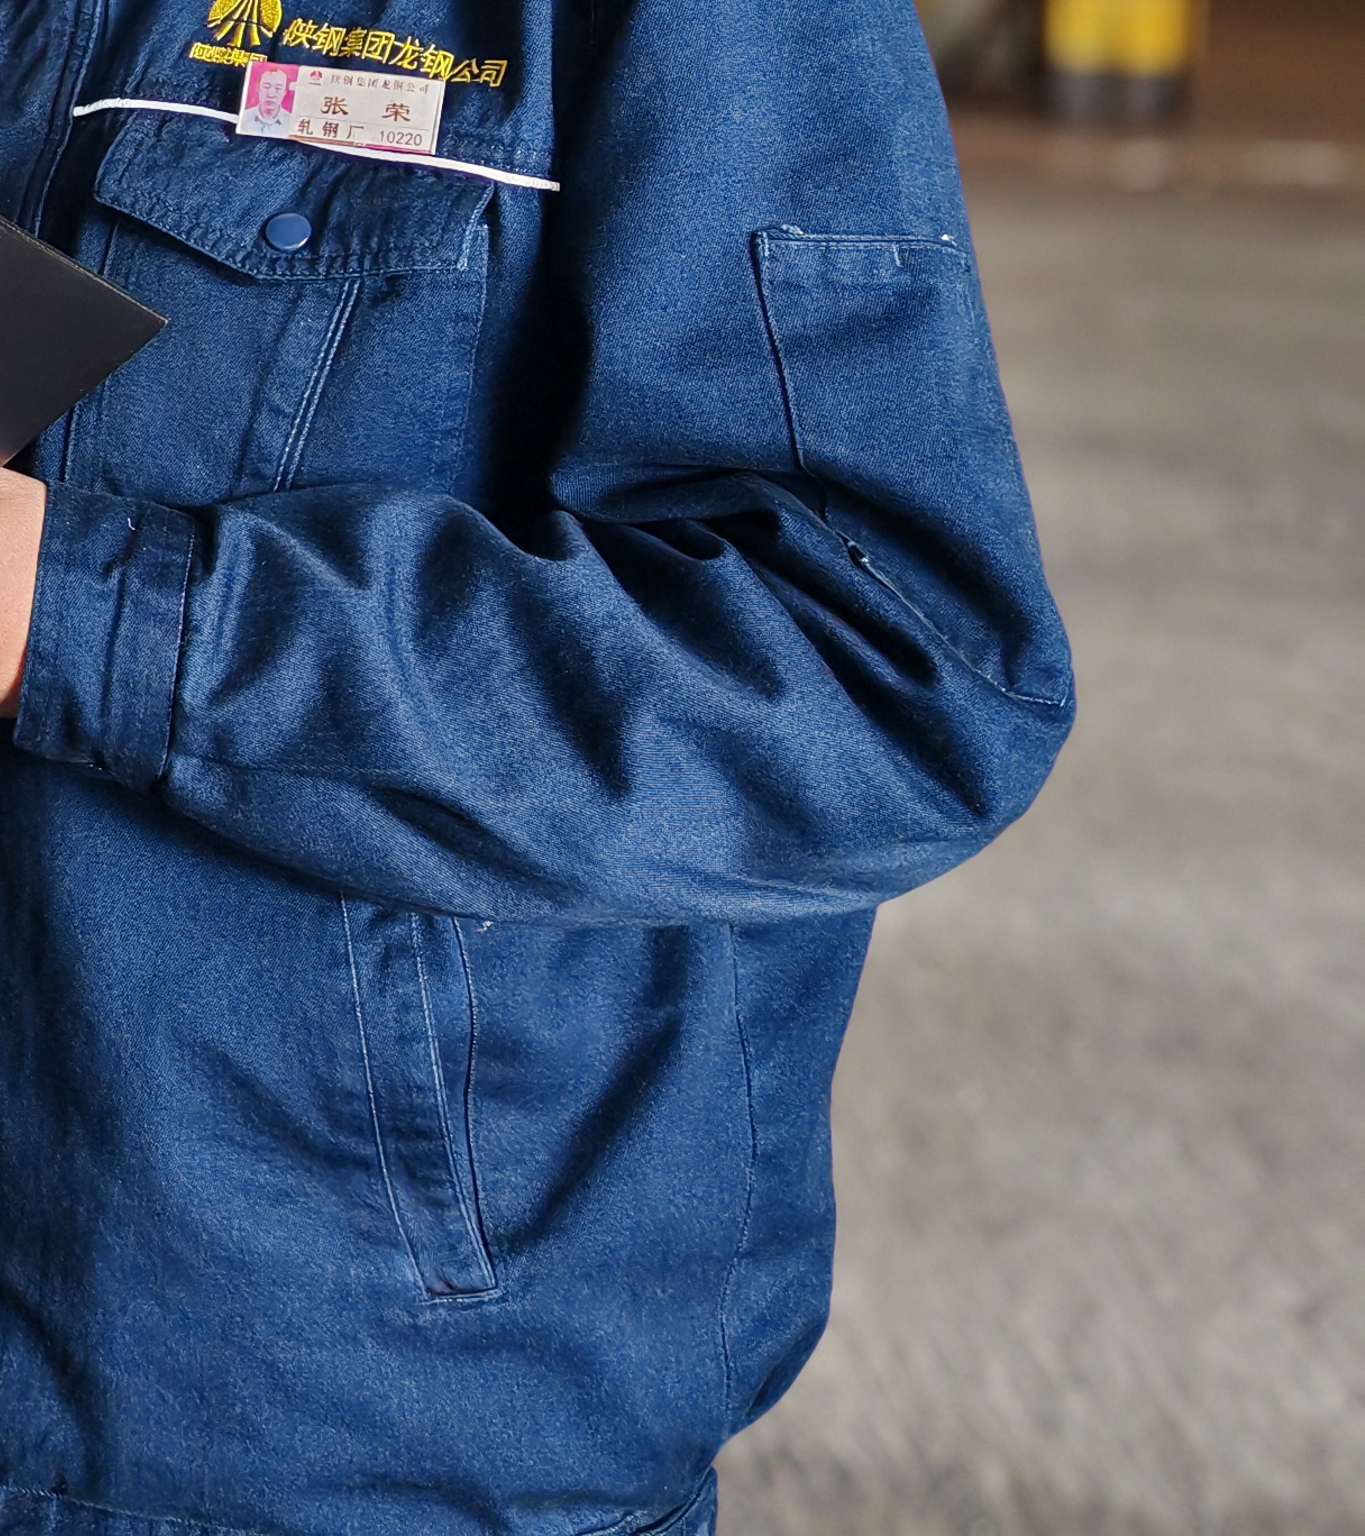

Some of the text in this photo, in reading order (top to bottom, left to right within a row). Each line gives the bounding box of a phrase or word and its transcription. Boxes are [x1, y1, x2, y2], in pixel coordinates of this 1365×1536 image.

[282, 17, 508, 88] 陕钢集团龙钢公司
[297, 118, 423, 147] 轧钢厂 10220
